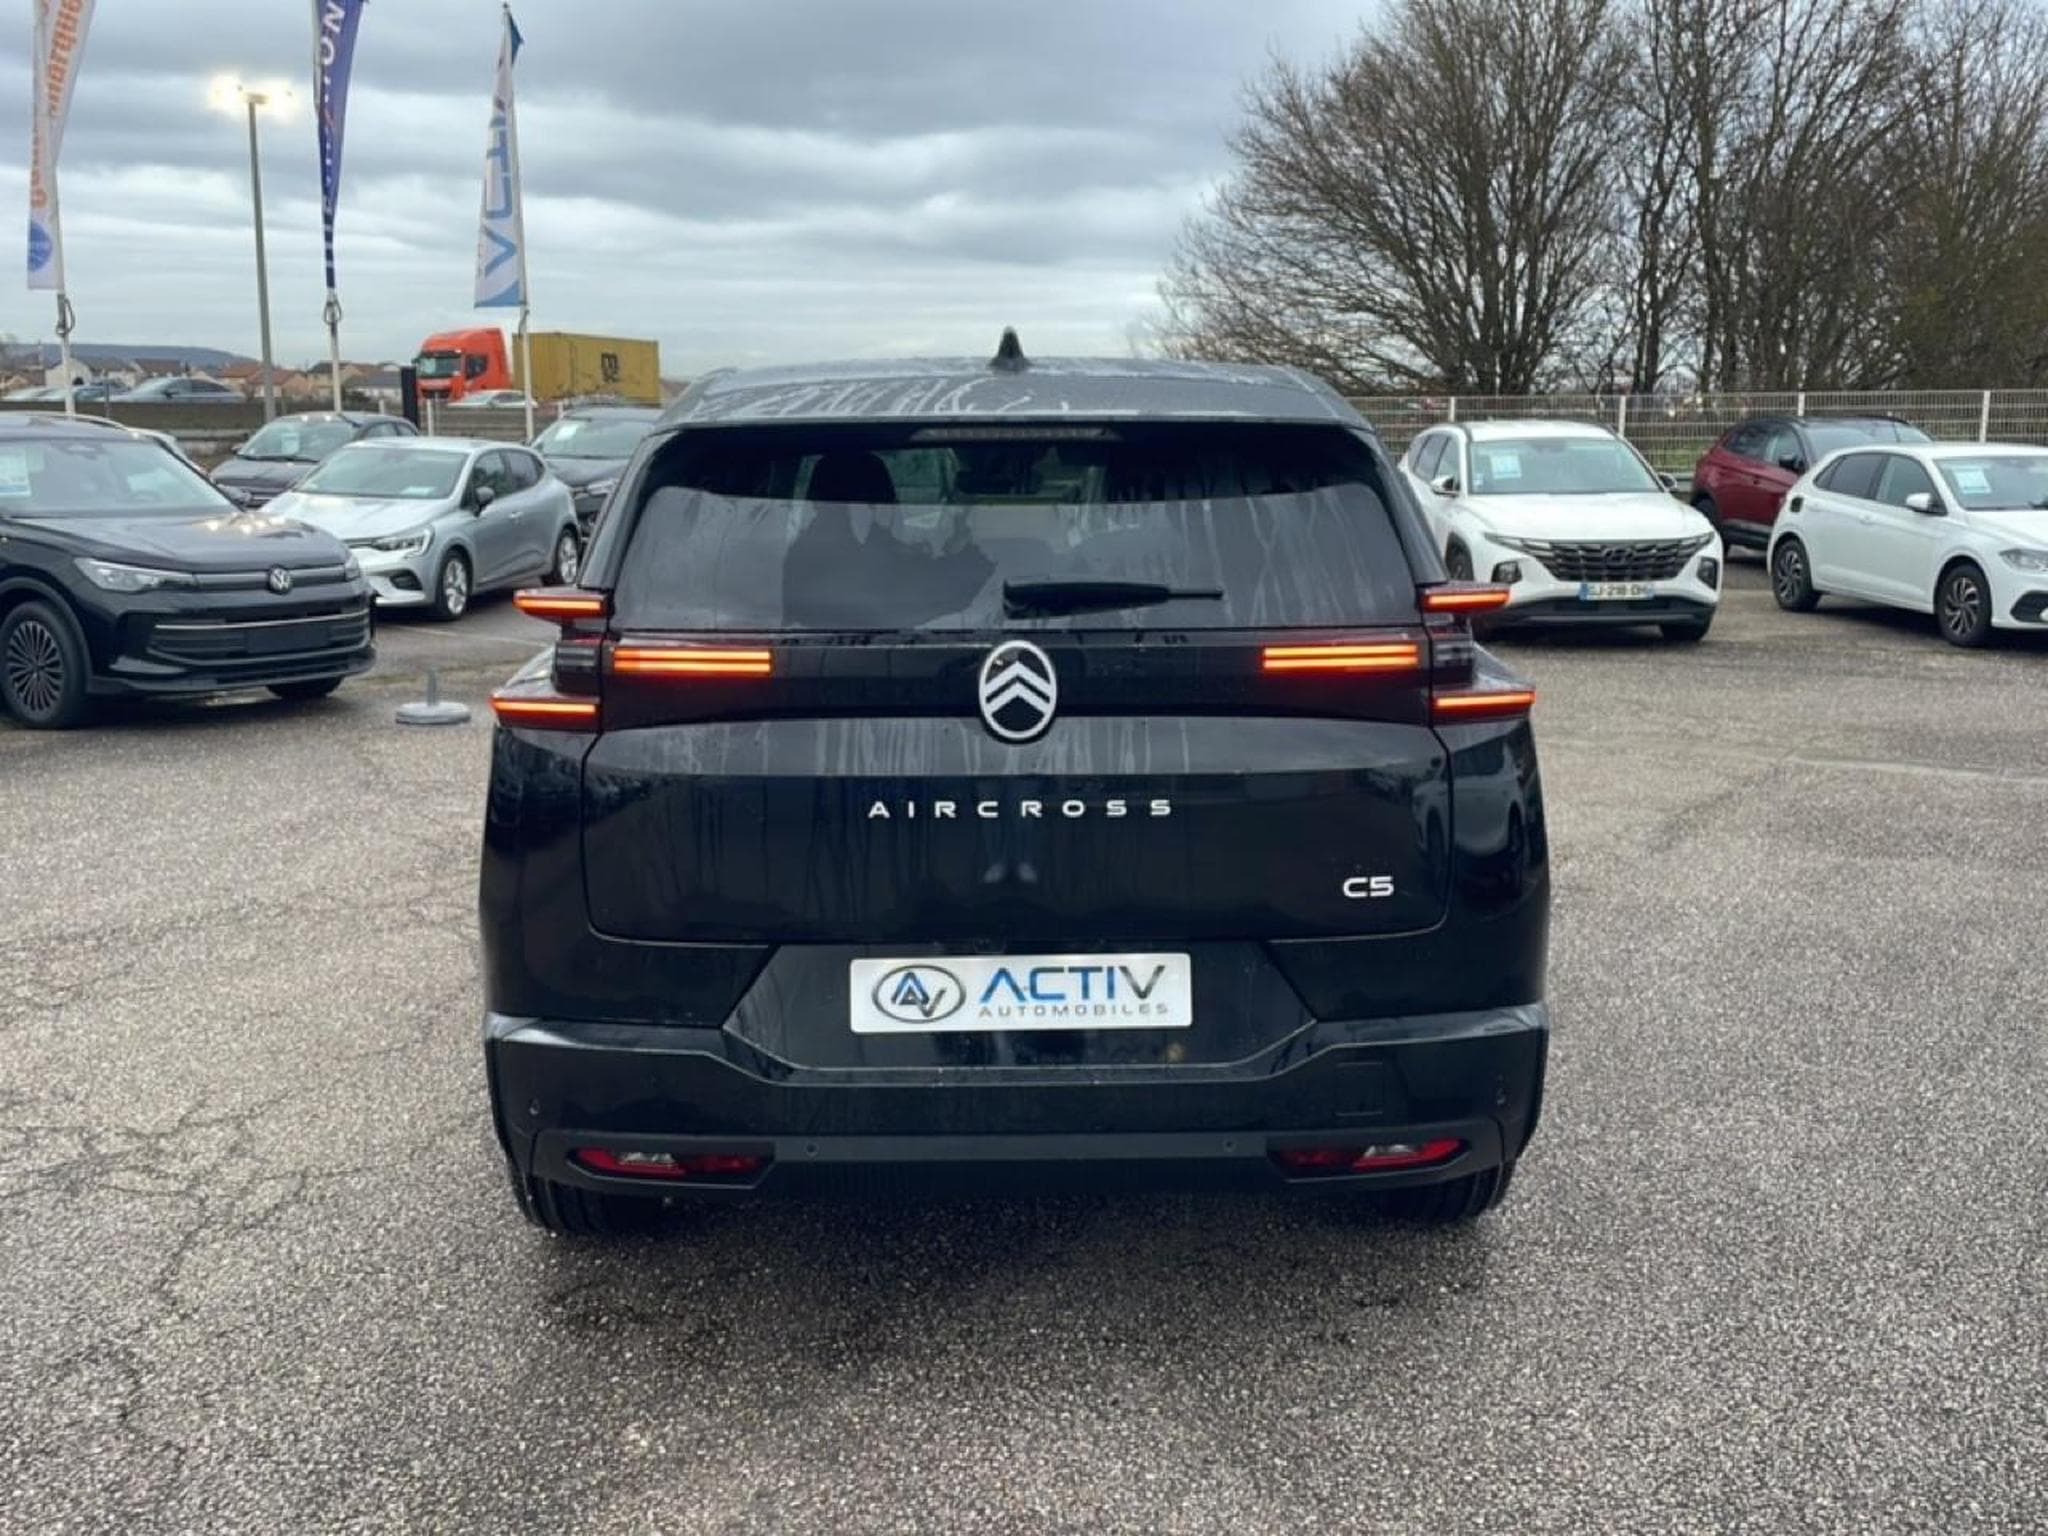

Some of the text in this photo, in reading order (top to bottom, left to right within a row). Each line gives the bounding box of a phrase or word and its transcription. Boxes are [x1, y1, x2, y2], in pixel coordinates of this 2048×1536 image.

[868, 799, 1171, 818] AIRCROSS
[1343, 876, 1394, 898] C5
[980, 965, 1165, 1003] ACTIV
[979, 1003, 1169, 1019] AUTOMOBILES
